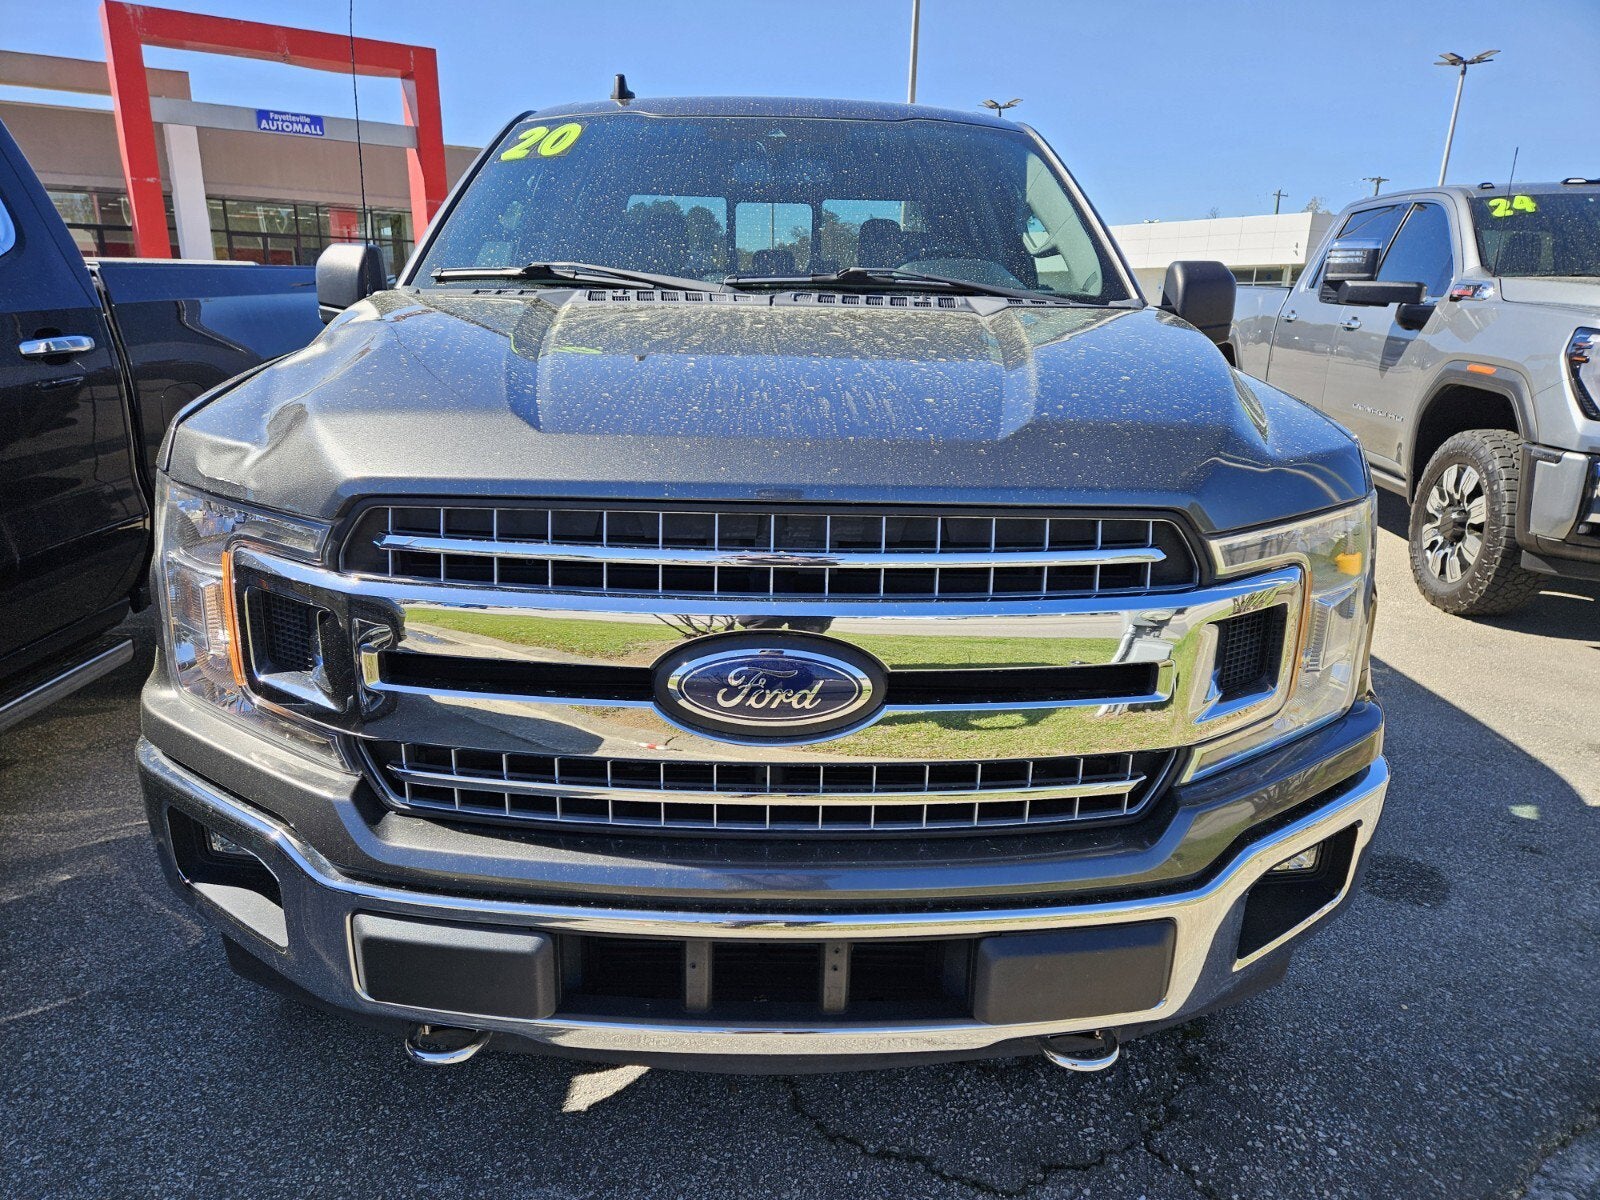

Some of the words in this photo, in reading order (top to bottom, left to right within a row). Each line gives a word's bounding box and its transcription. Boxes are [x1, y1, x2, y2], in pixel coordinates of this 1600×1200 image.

[261, 119, 322, 135] AUTOMALL
[270, 112, 310, 123] Fayetteville
[500, 123, 582, 161] 20
[1489, 195, 1536, 217] 24
[717, 667, 825, 709] Ford
